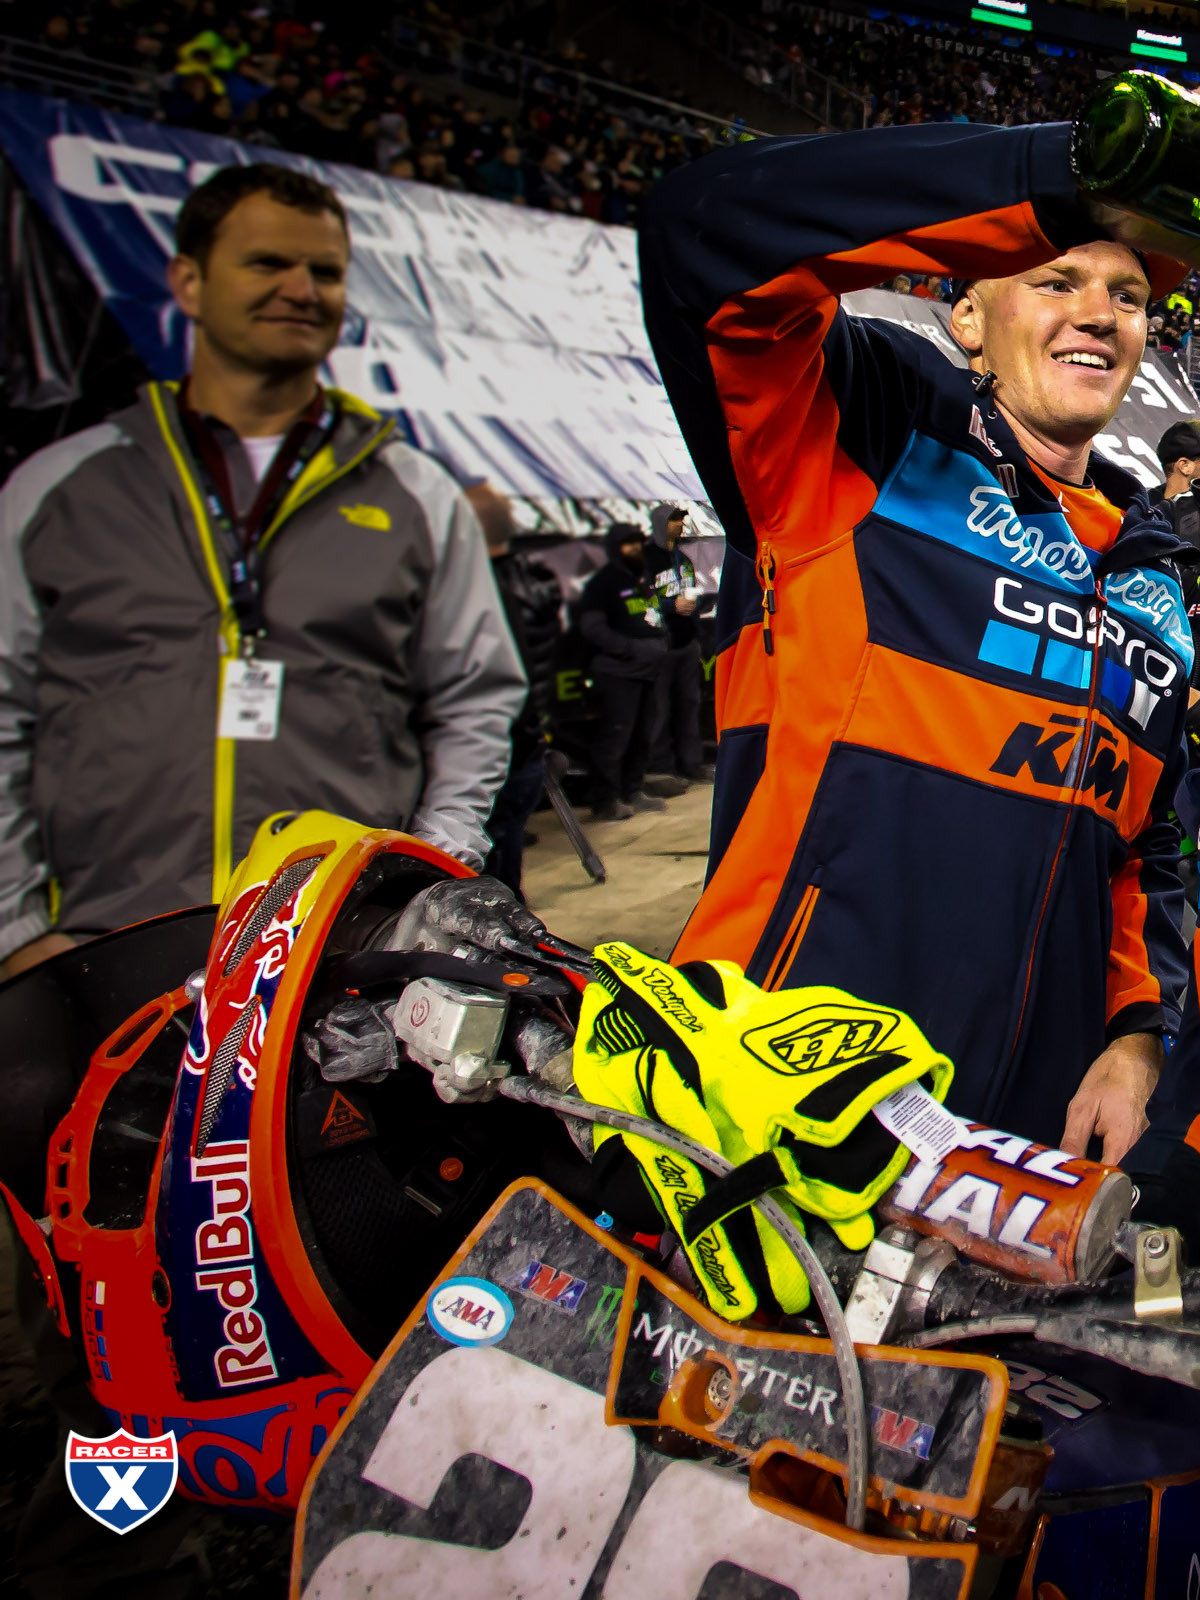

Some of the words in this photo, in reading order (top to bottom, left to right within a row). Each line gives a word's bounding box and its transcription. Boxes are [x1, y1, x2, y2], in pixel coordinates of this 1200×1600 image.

[994, 576, 1178, 688] GoPro
[989, 713, 1129, 812] KTM
[190, 1139, 255, 1265] Bull
[214, 1265, 279, 1388] Red
[441, 1296, 496, 1331] AMA
[505, 1259, 587, 1316] AMA
[633, 1312, 838, 1426] MOSTER
